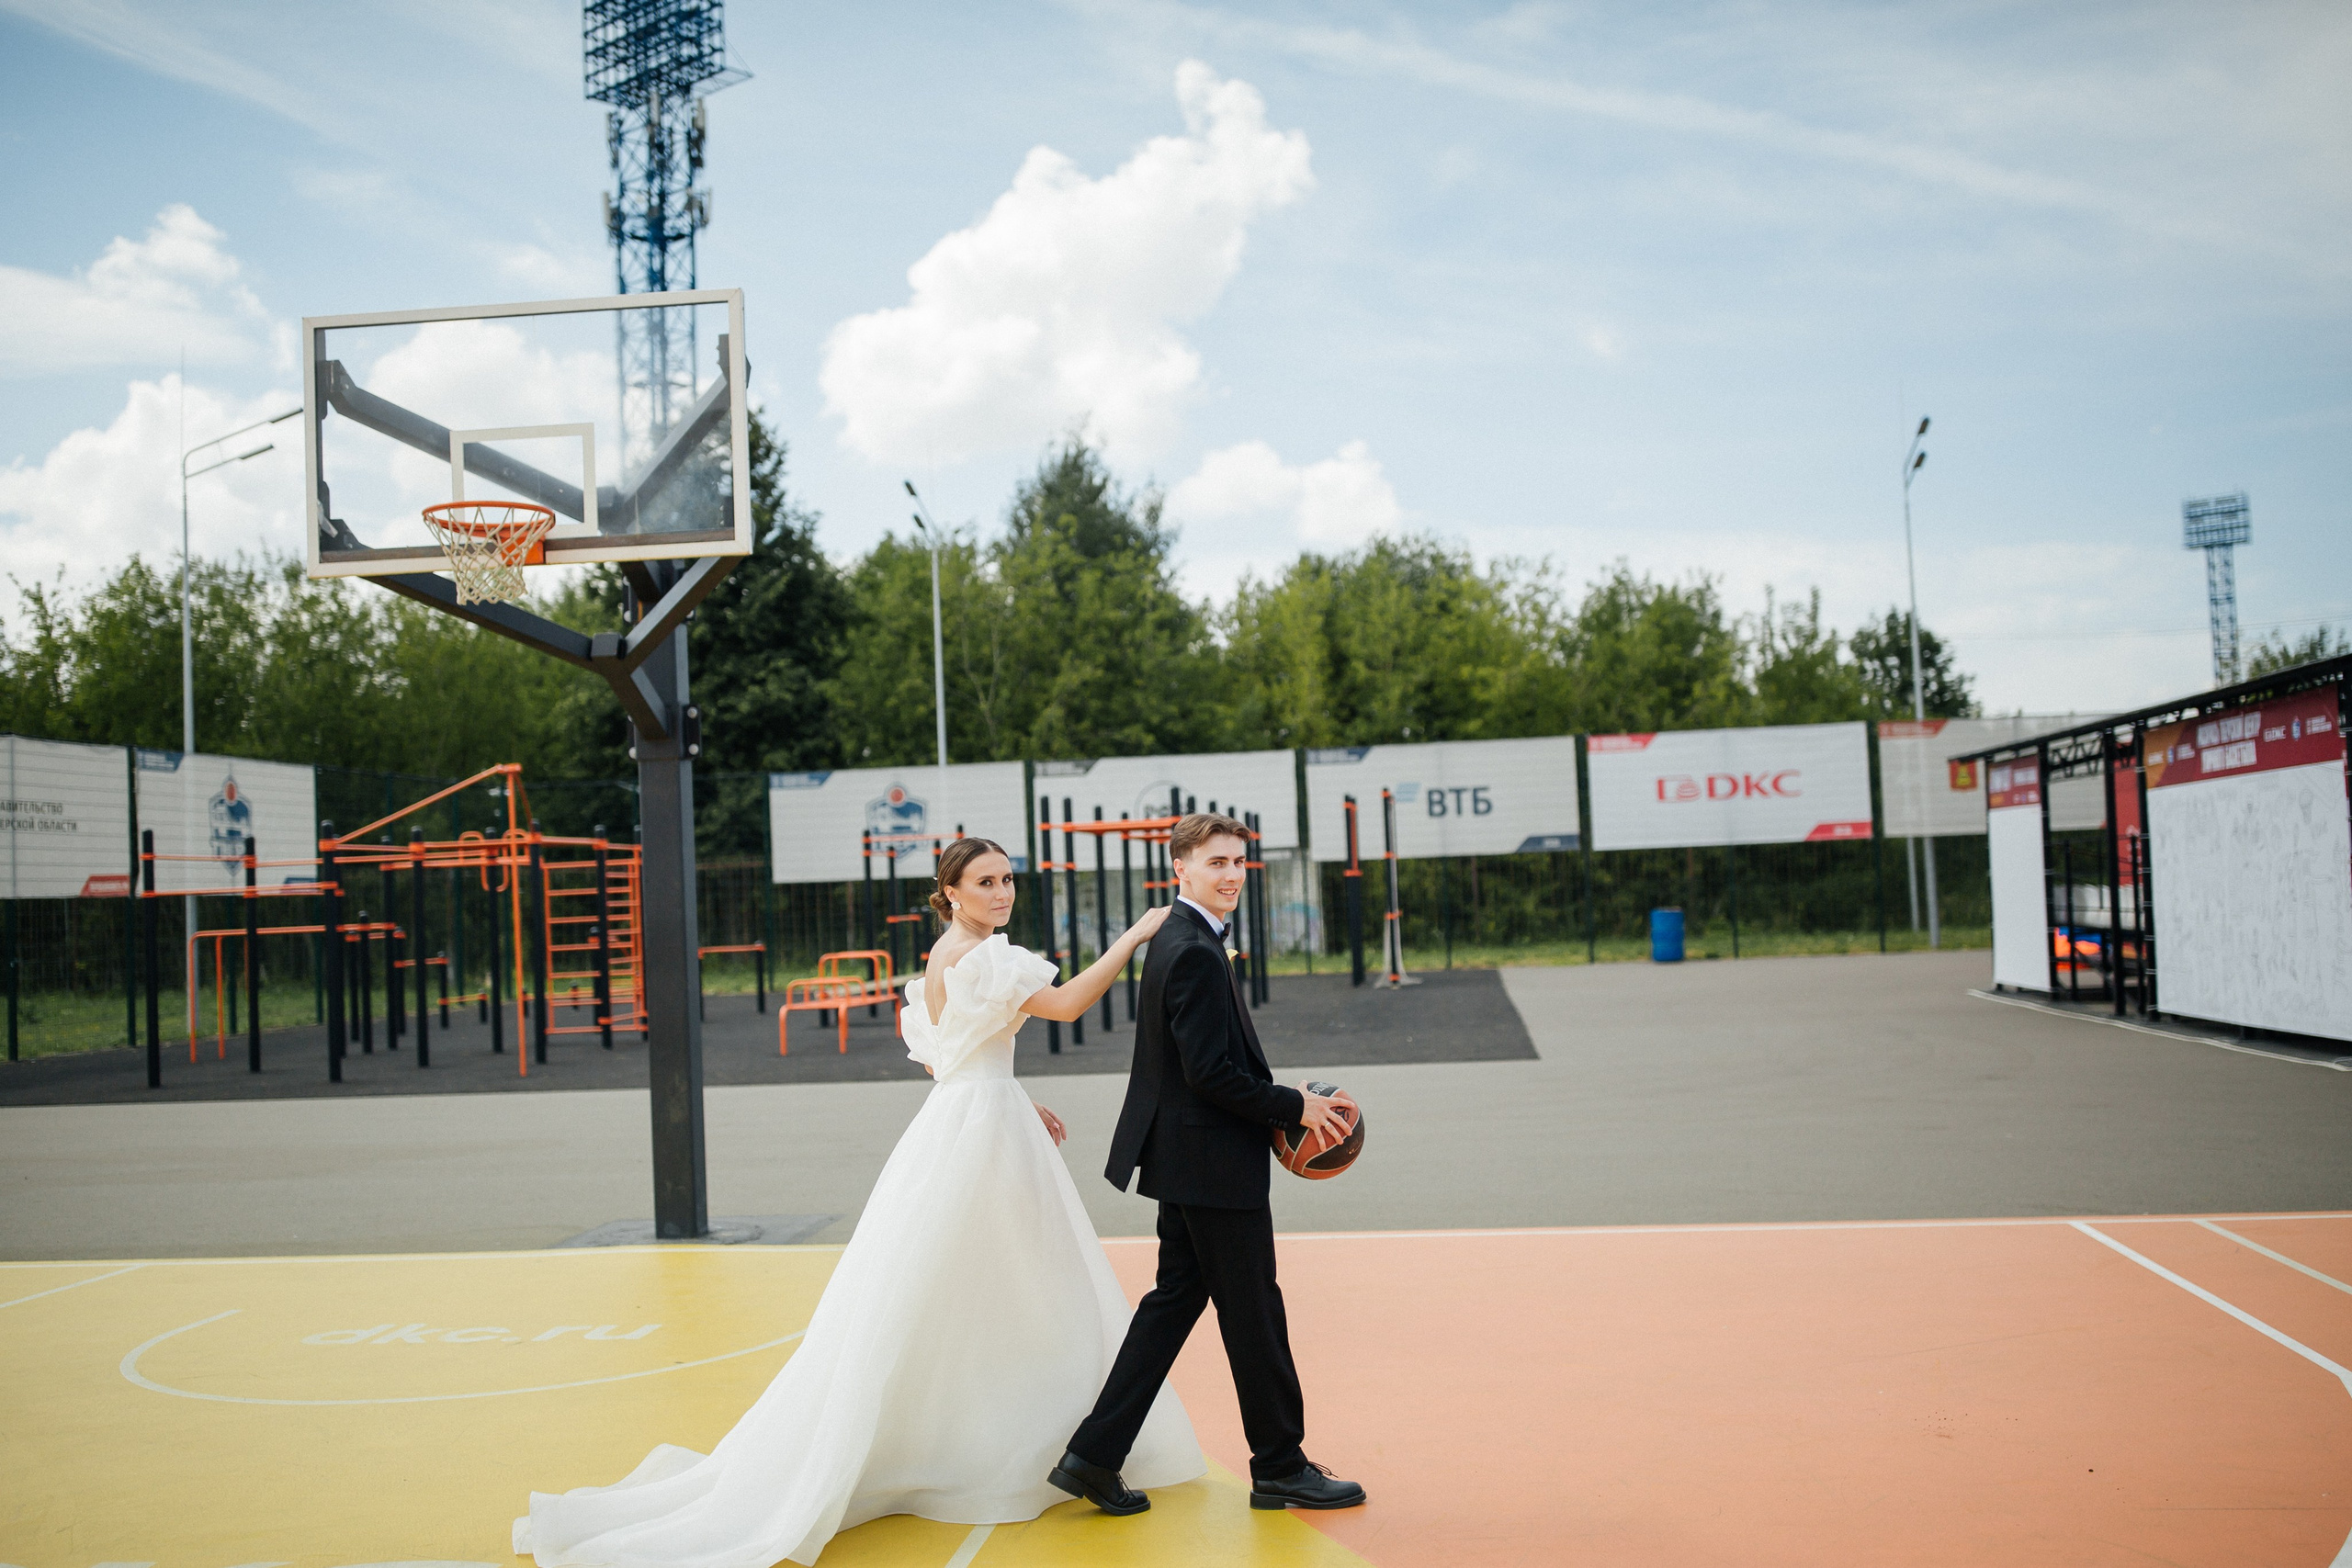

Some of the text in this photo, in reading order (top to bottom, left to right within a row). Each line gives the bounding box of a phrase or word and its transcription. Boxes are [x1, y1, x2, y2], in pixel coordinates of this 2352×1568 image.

[1706, 769, 1802, 800] DKC
[1427, 786, 1493, 817] ВТБ
[38, 818, 77, 833] ОБЛАСТИ
[300, 1323, 662, 1345] dkc.ru
